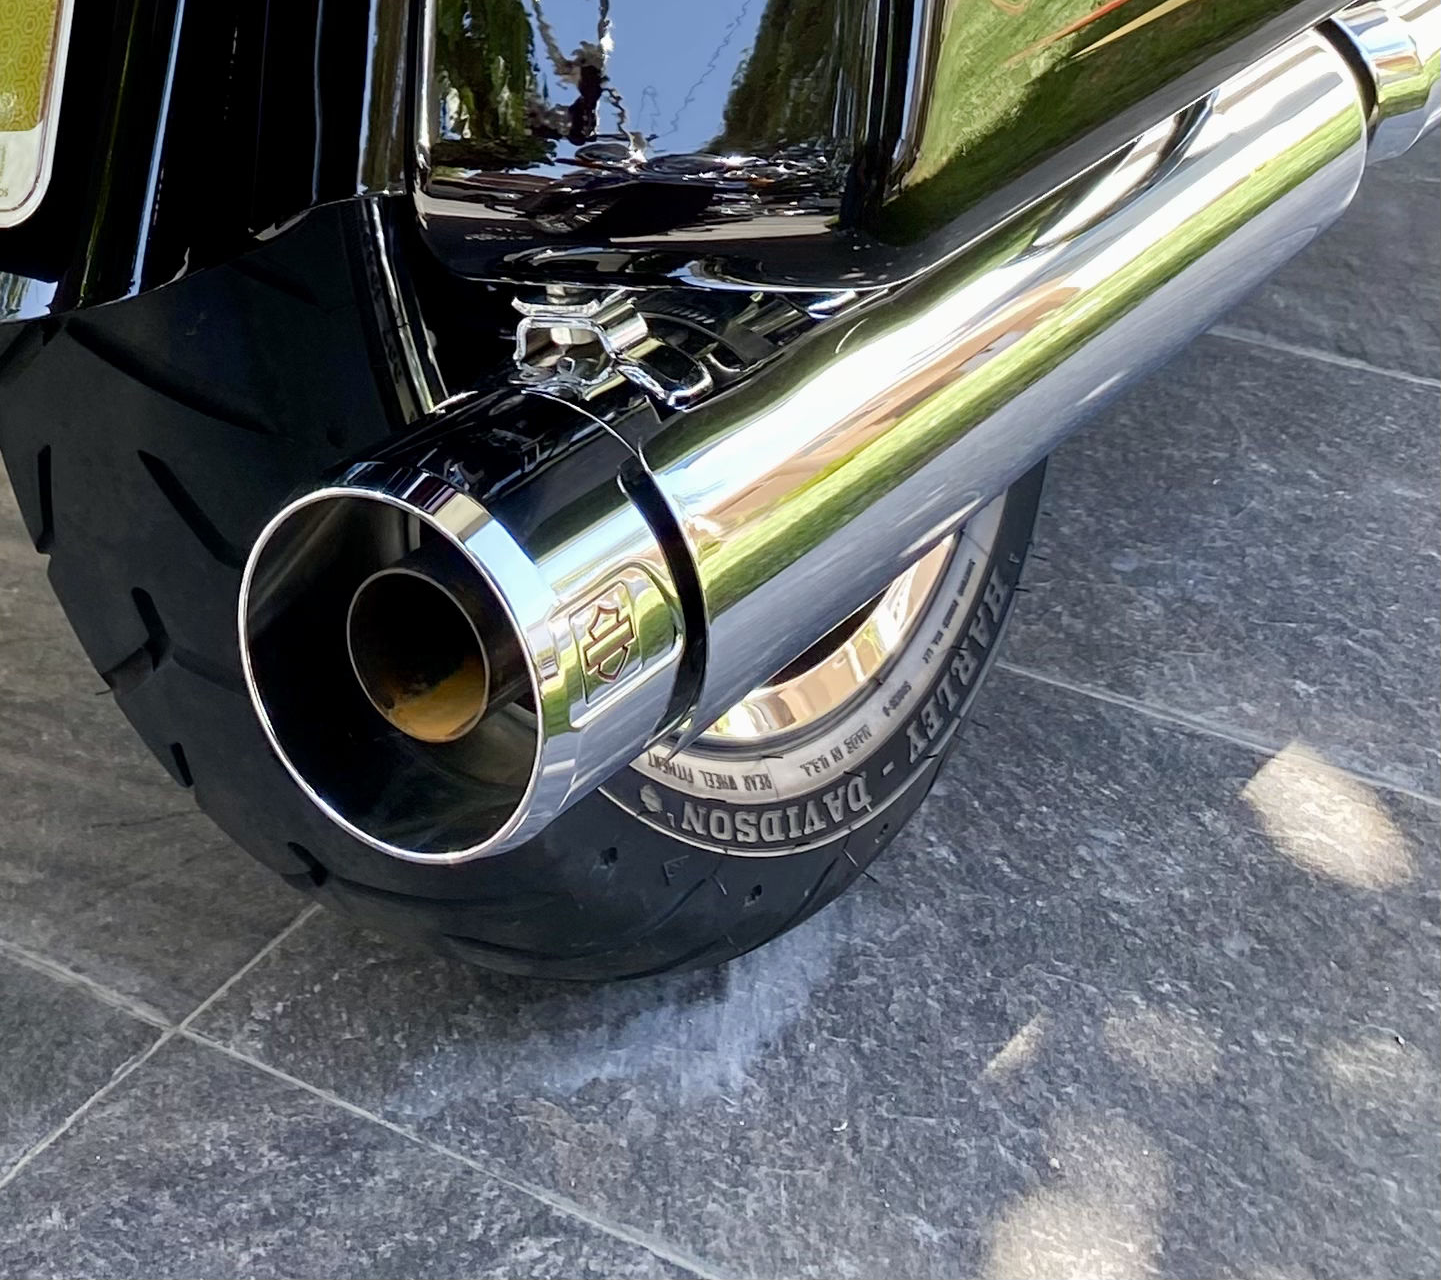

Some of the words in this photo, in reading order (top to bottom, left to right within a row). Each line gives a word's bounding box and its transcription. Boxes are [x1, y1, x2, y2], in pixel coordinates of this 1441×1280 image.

[907, 564, 1011, 765] HARLEY
[698, 769, 738, 790] WHEEL
[744, 773, 774, 790] REAR
[680, 770, 874, 843] DAVIDSON
